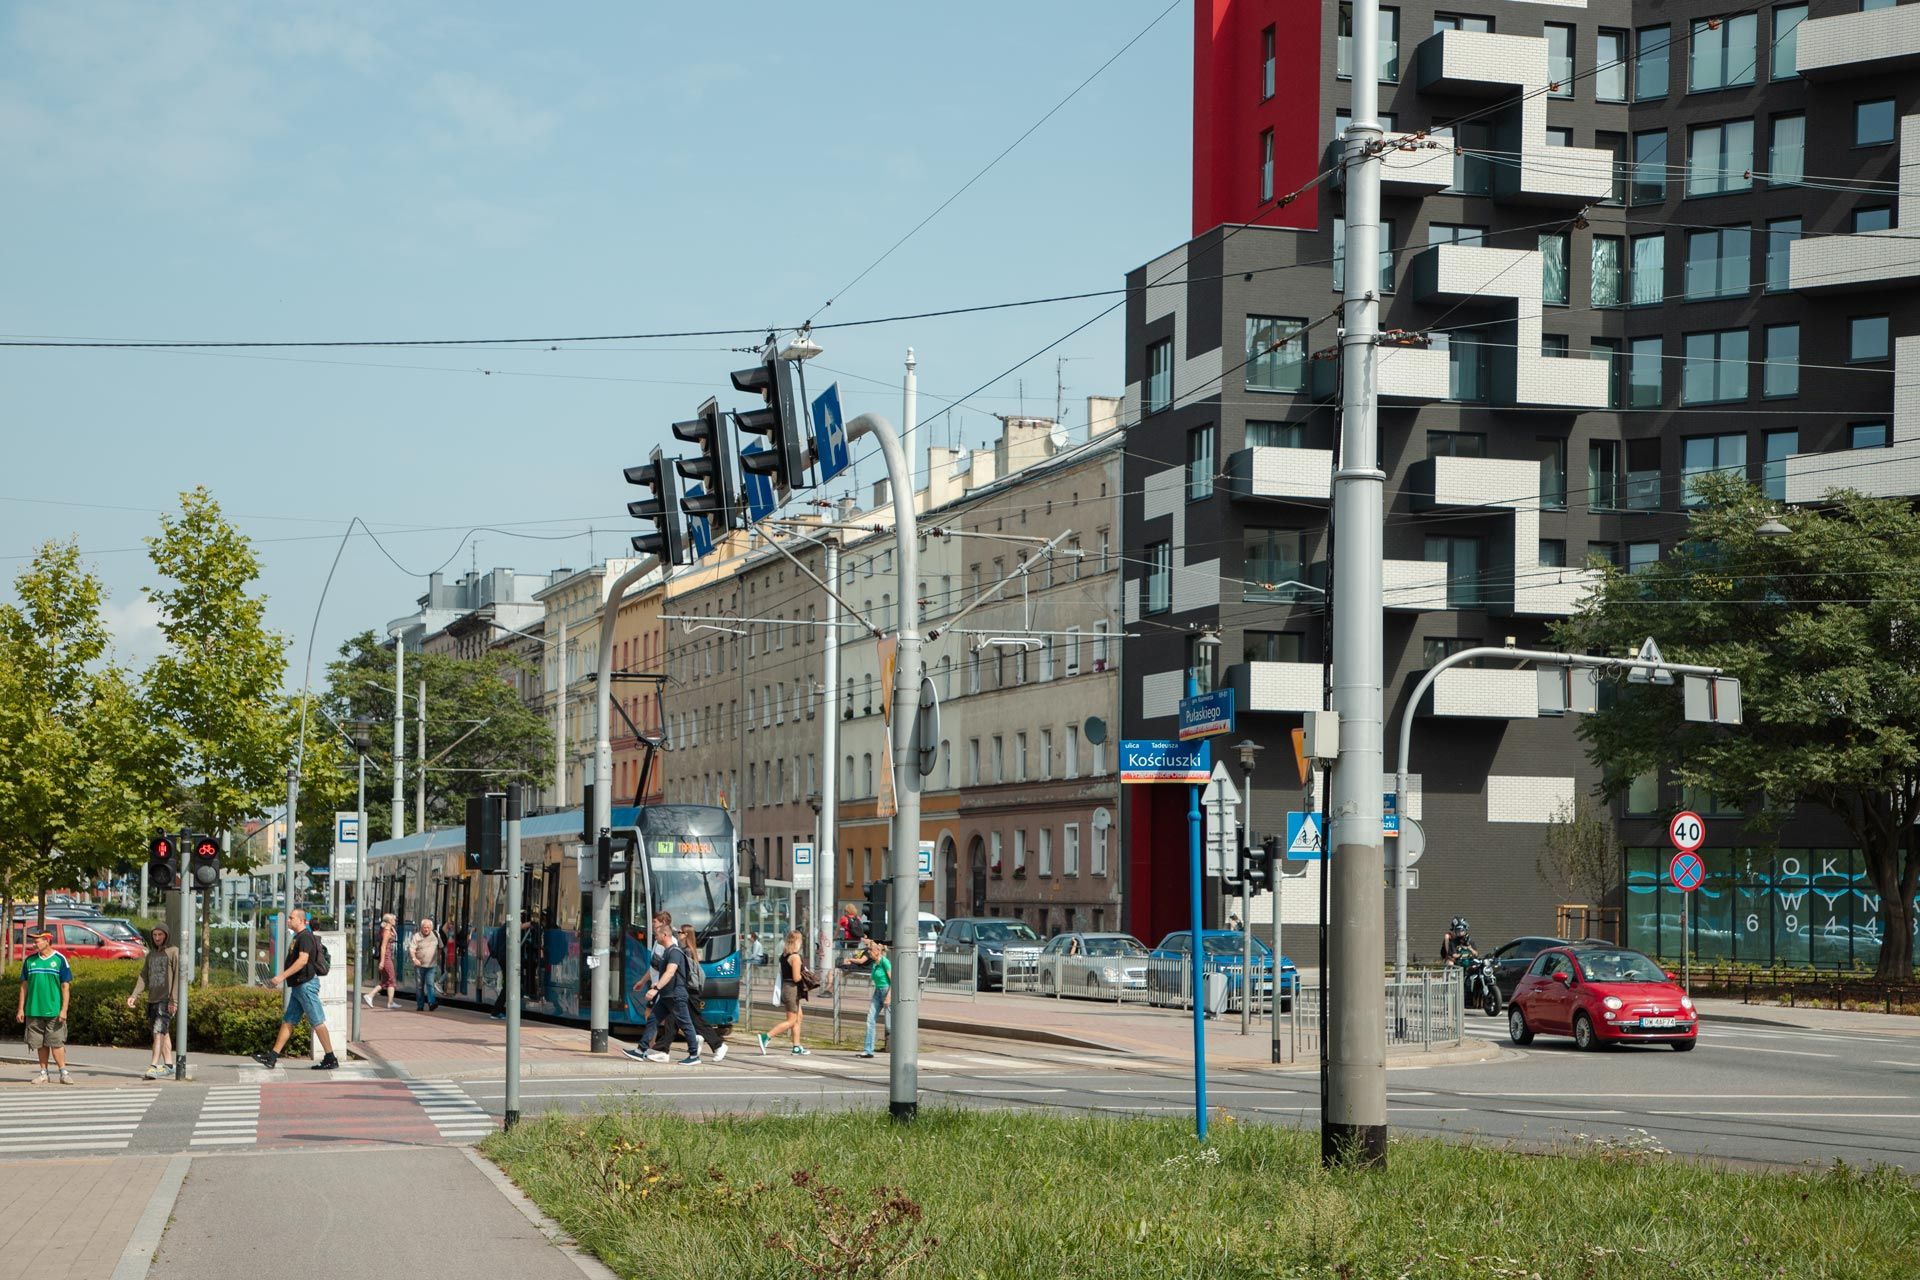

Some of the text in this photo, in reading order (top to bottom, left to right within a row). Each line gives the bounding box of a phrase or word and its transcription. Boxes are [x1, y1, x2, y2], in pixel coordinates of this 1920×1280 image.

[1185, 705, 1221, 723] Pułaskiego
[1128, 752, 1201, 767] Kościuszki
[1675, 822, 1700, 841] 40
